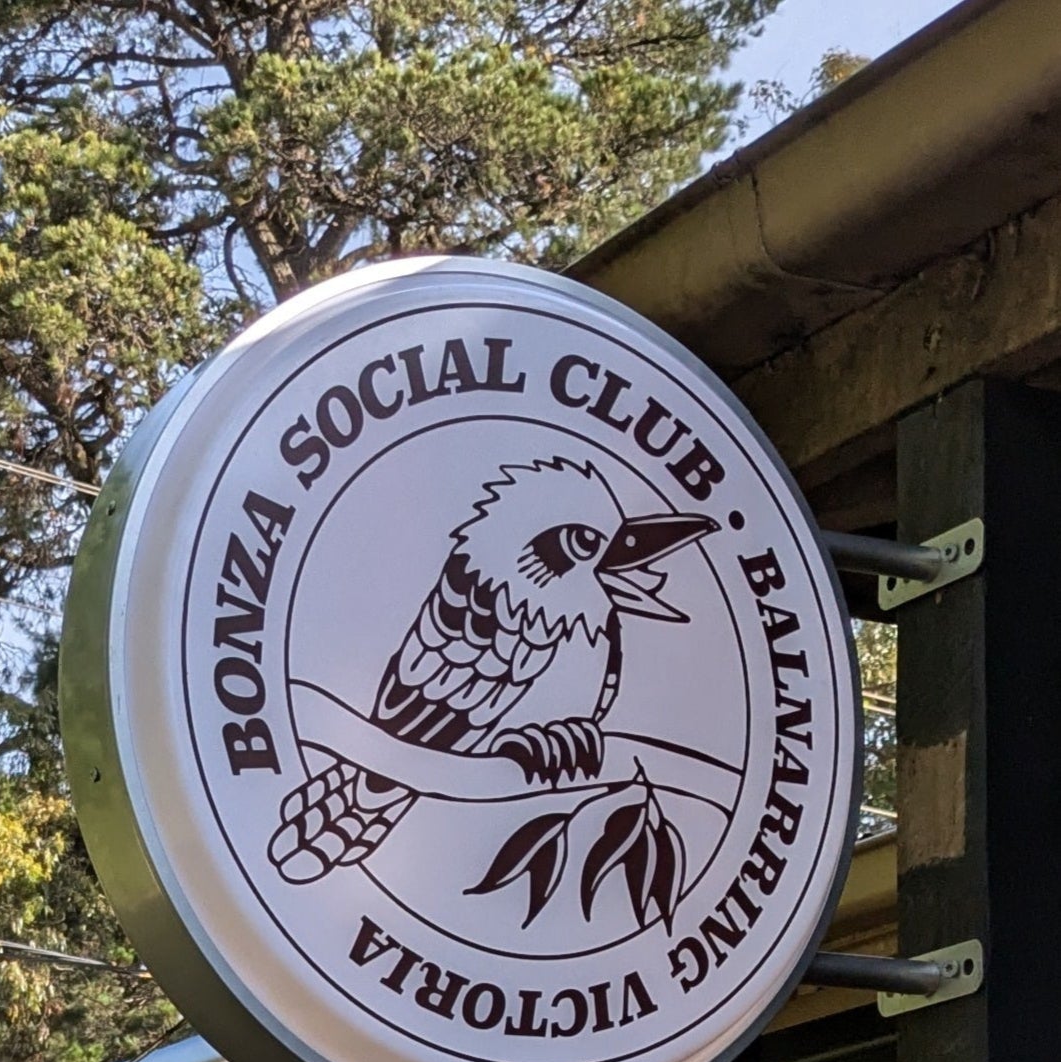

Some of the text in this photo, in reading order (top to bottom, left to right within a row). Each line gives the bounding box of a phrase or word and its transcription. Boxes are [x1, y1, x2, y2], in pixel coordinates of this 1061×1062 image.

[213, 337, 726, 776] BONZA SOCIAL CLUB
[348, 546, 814, 1039] BALNARRING VICTORIA
